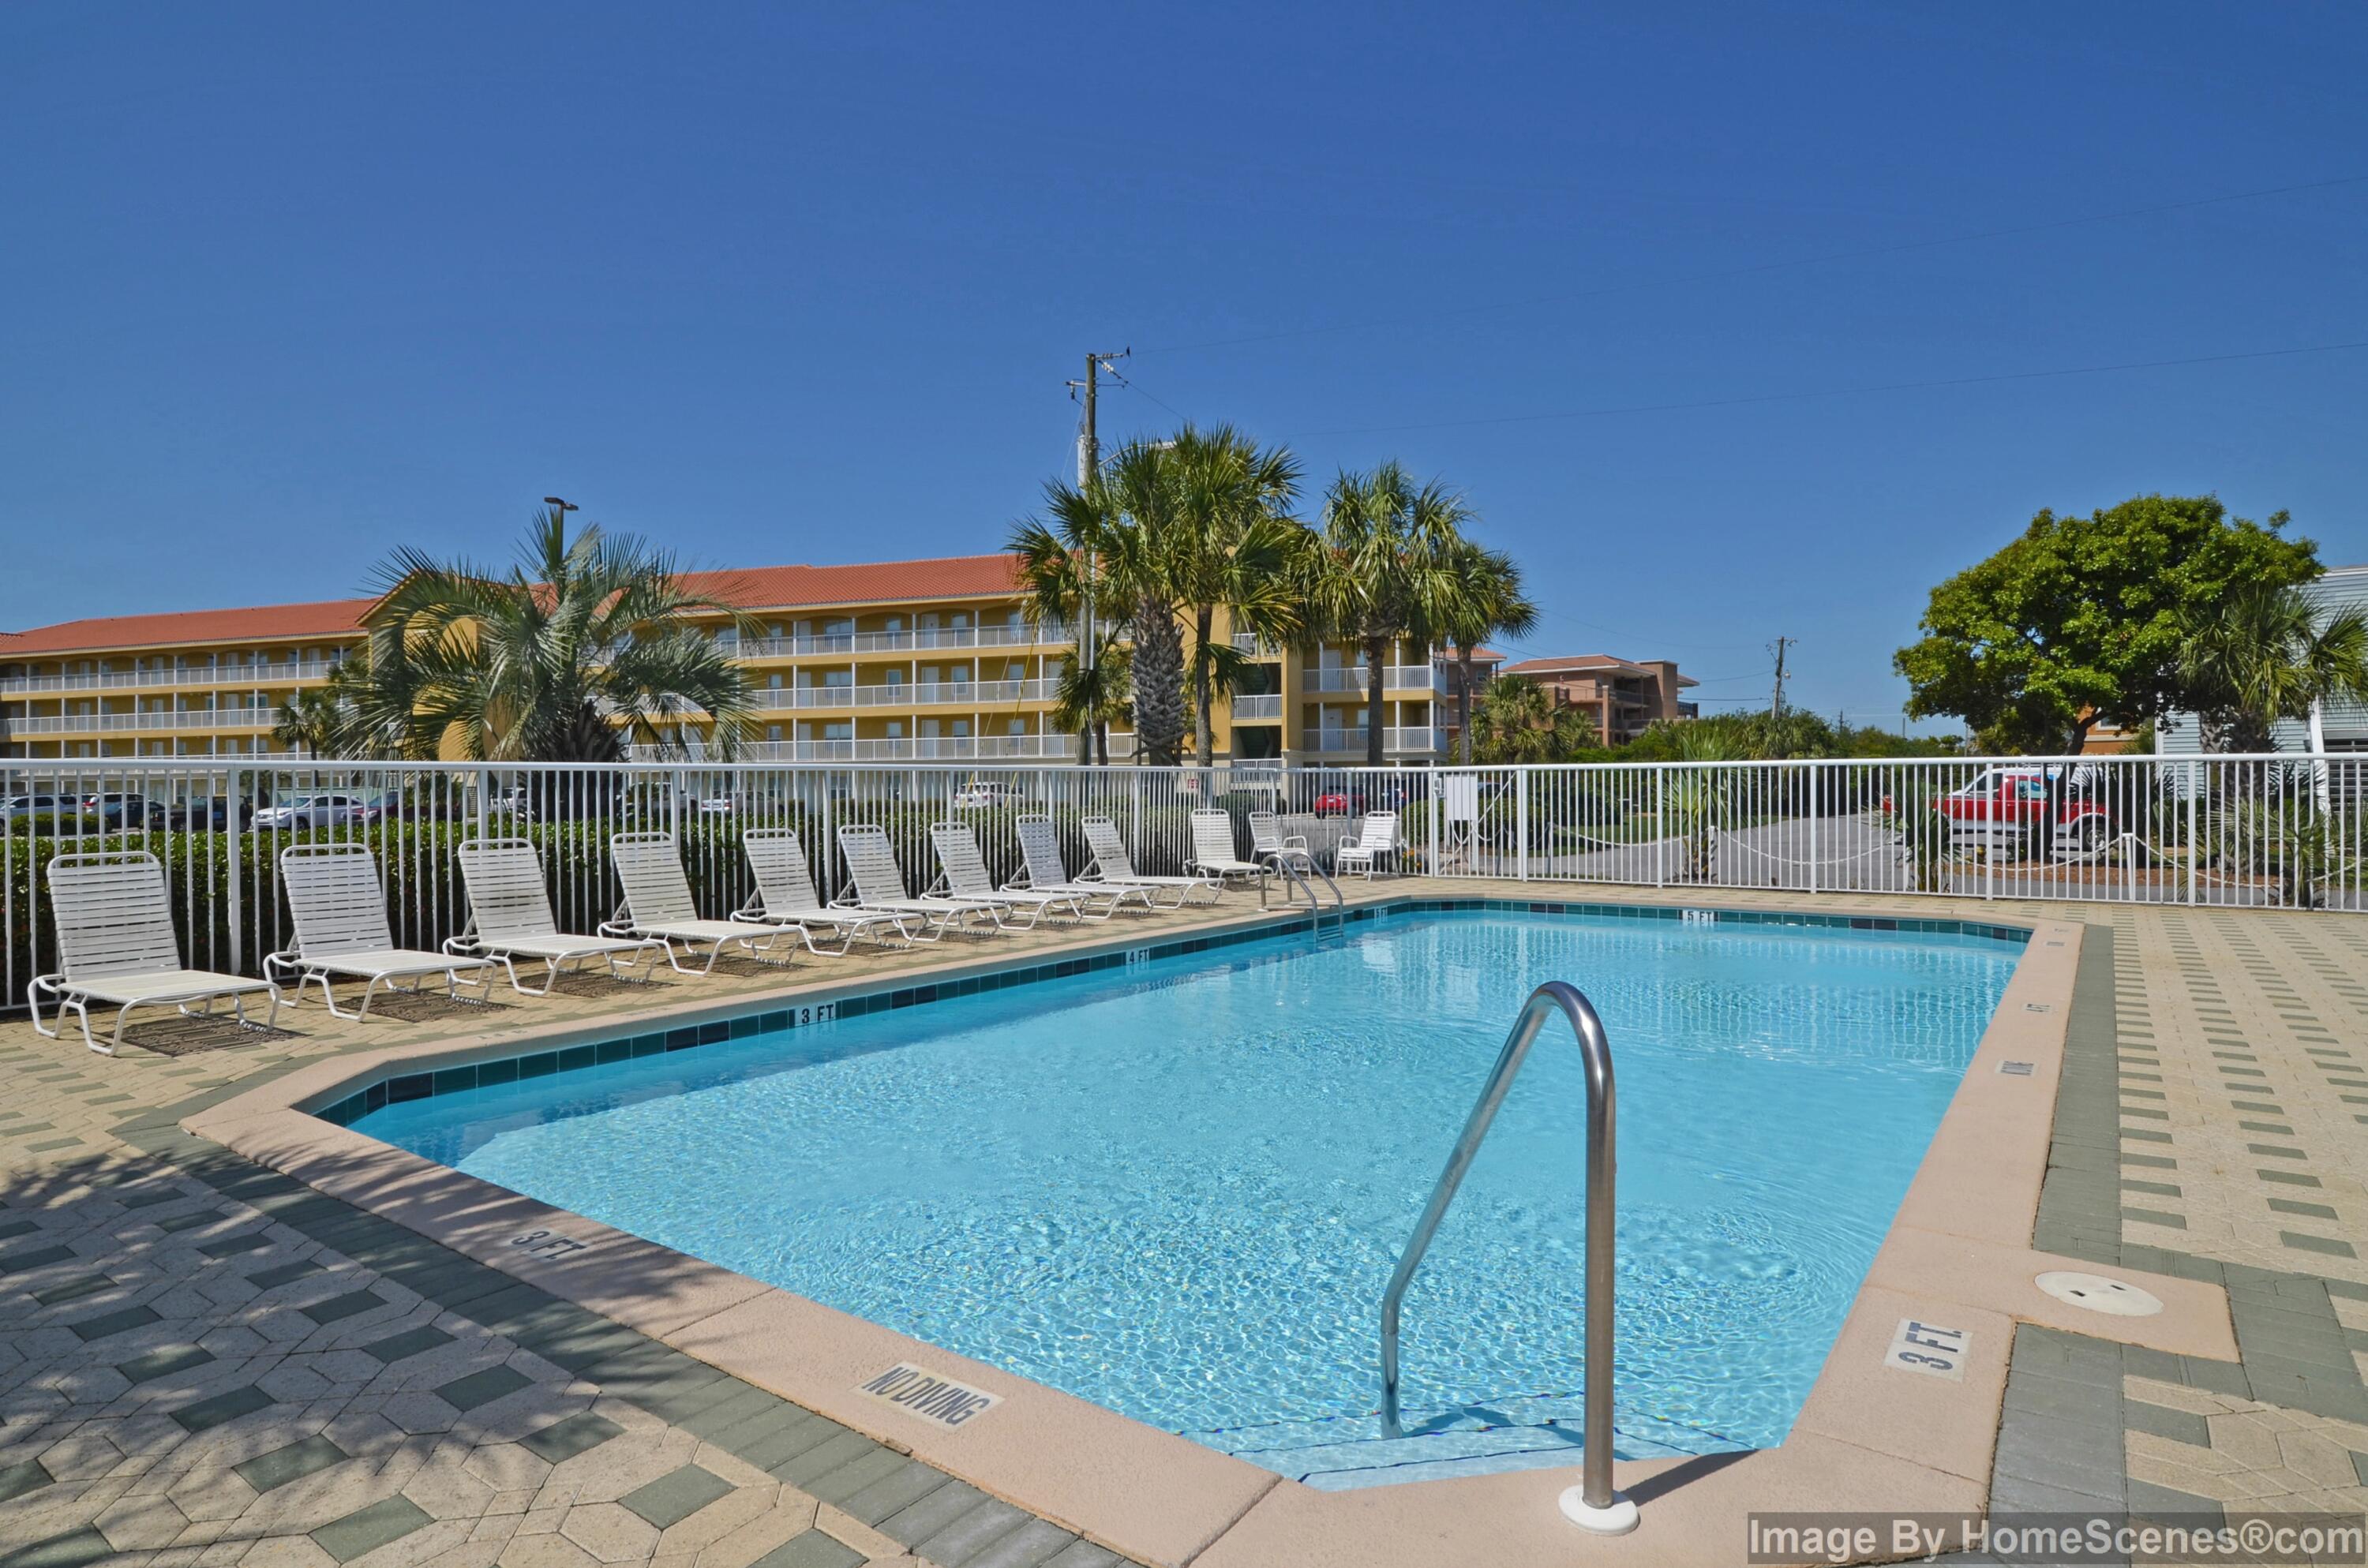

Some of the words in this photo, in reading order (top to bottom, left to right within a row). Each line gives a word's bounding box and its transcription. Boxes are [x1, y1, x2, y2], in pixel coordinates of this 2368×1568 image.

[1688, 911, 1693, 922] 5
[1699, 911, 1711, 922] FT
[1130, 952, 1134, 964] 4
[1139, 949, 1148, 963] FT
[802, 1008, 810, 1024] 3
[511, 1231, 550, 1244] 3
[1898, 1351, 1953, 1370] 3
[861, 1366, 920, 1396] NO
[890, 1376, 990, 1425] DIVING
